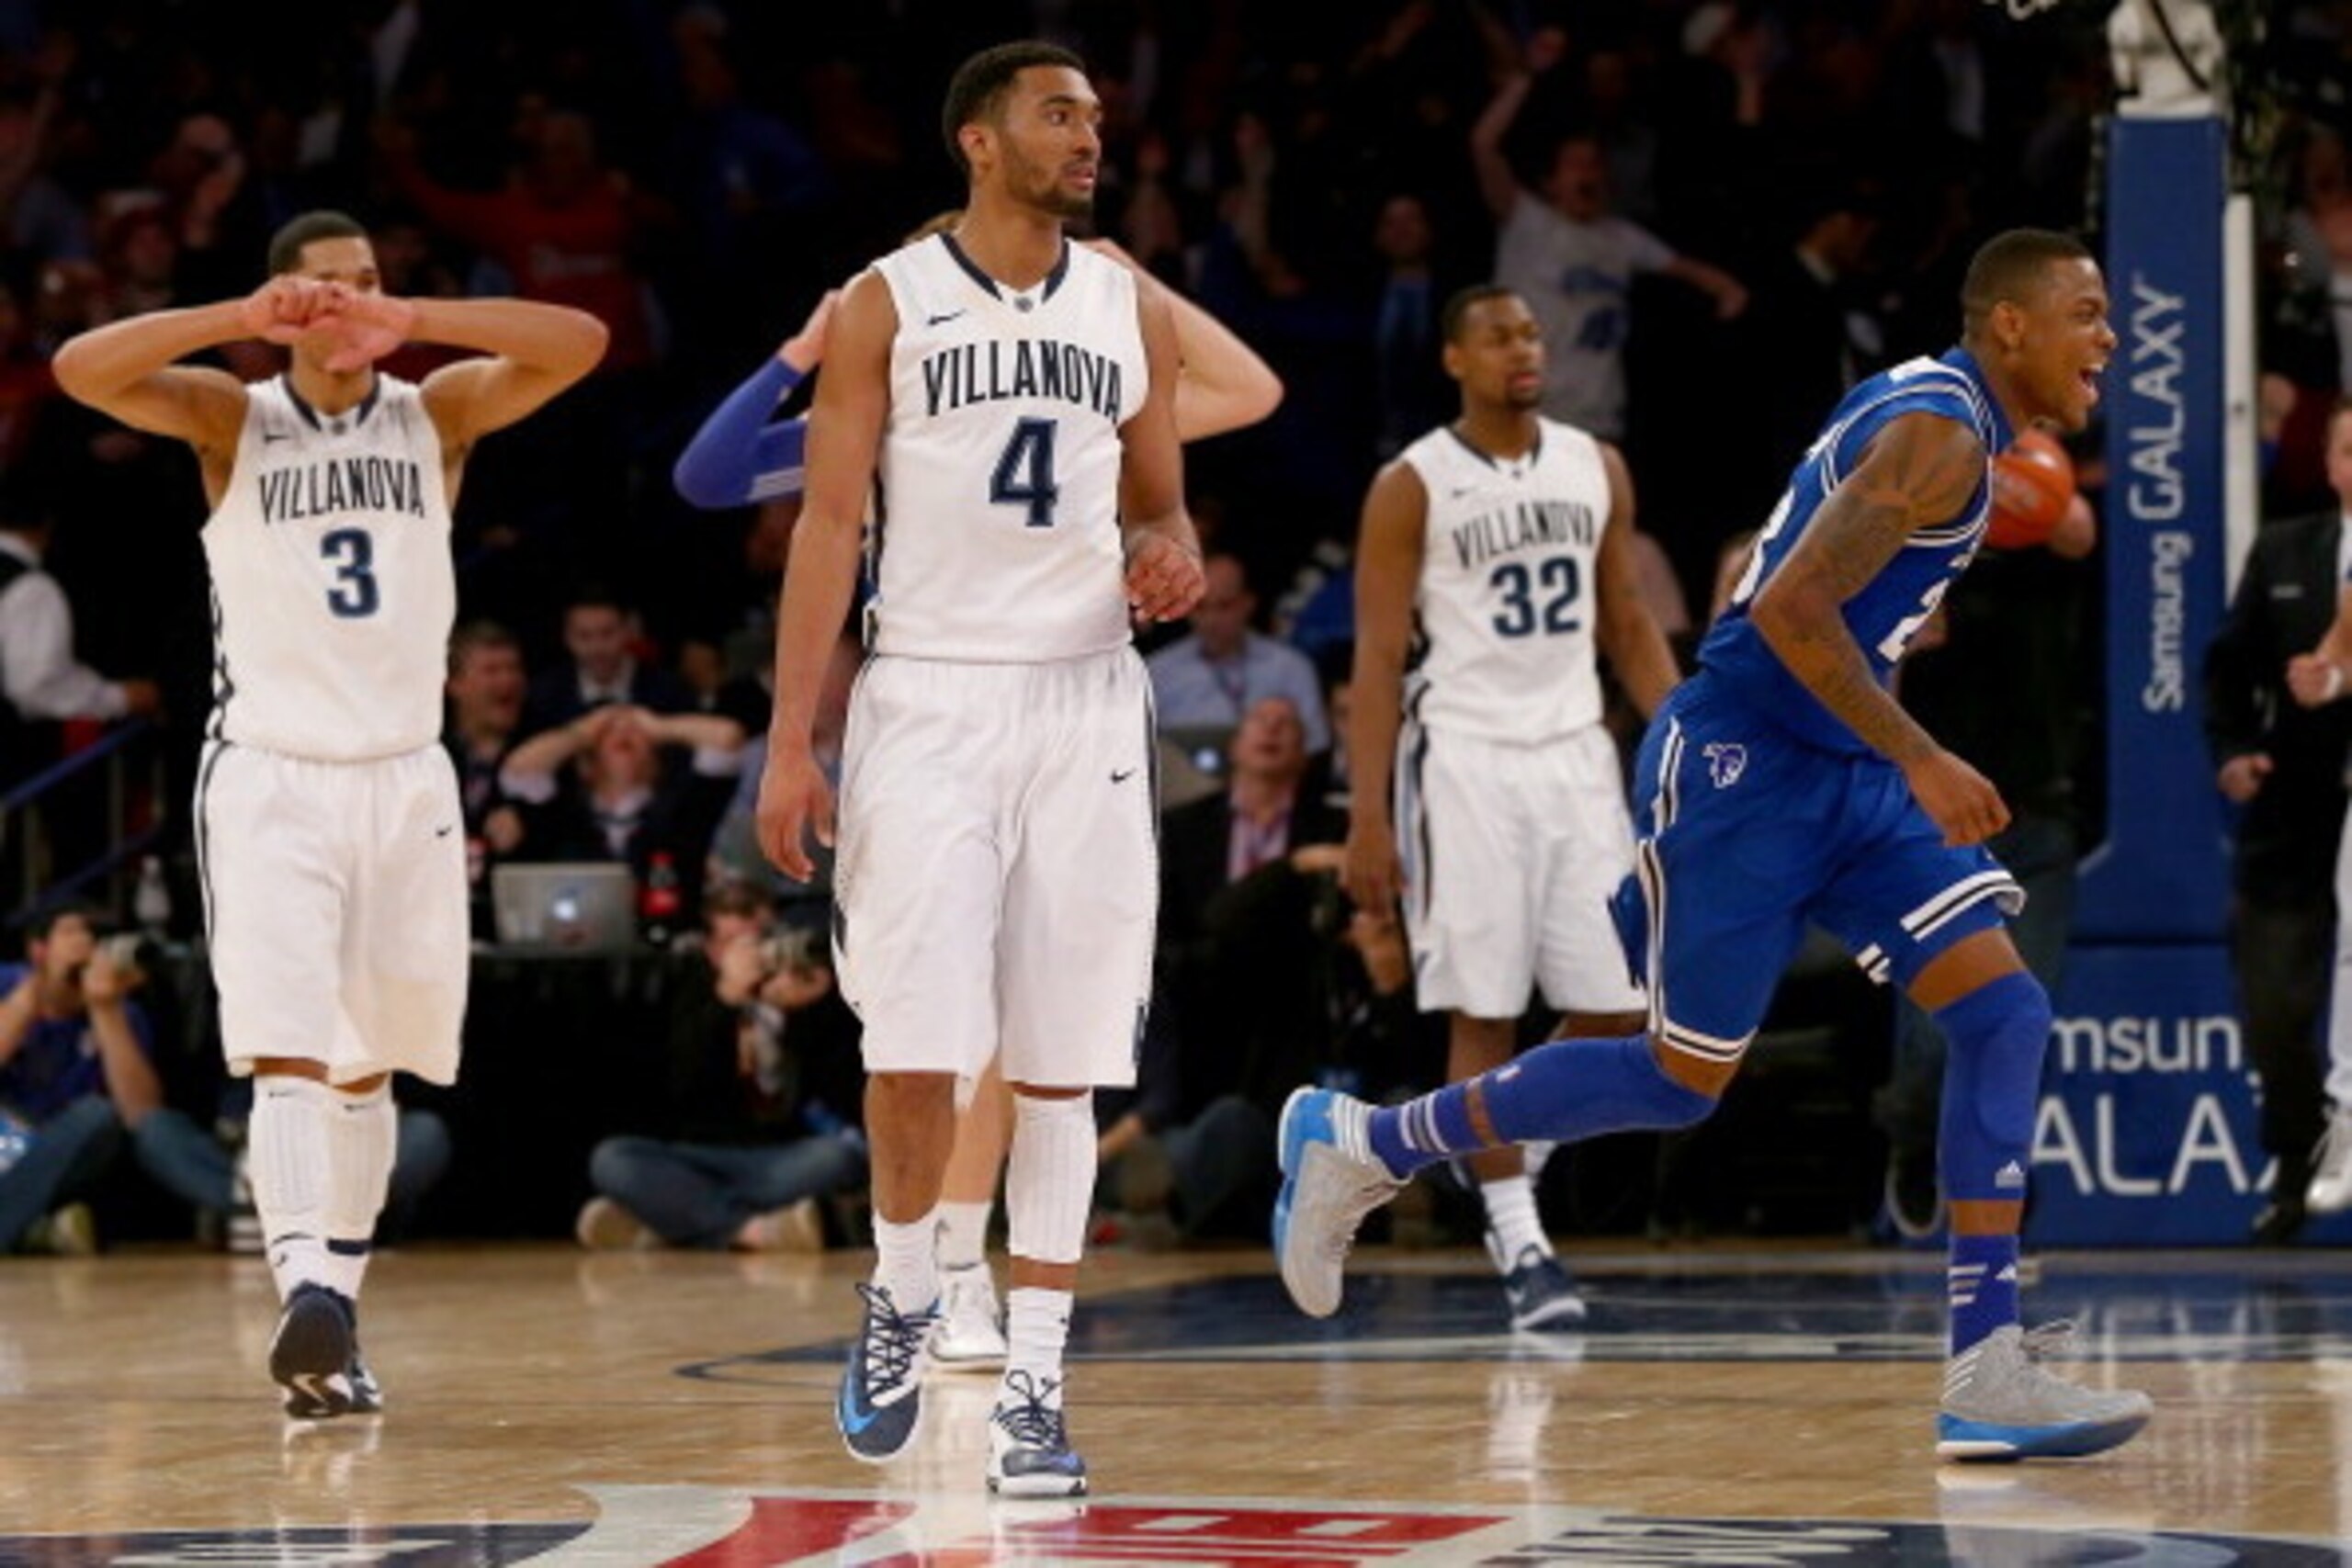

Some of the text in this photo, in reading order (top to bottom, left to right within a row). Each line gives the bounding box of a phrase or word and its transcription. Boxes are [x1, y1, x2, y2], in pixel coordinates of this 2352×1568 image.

[922, 339, 1122, 425] VILLANOVA
[259, 457, 425, 524] VILLANOVA
[989, 415, 1058, 527] 4
[2128, 275, 2195, 713] Samsung GALAXY
[320, 526, 379, 618] 3
[1453, 501, 1593, 570] VILLANOVA
[1489, 556, 1581, 638] 32
[2050, 1015, 2242, 1074] msun
[2030, 1091, 2279, 1195] ALA
